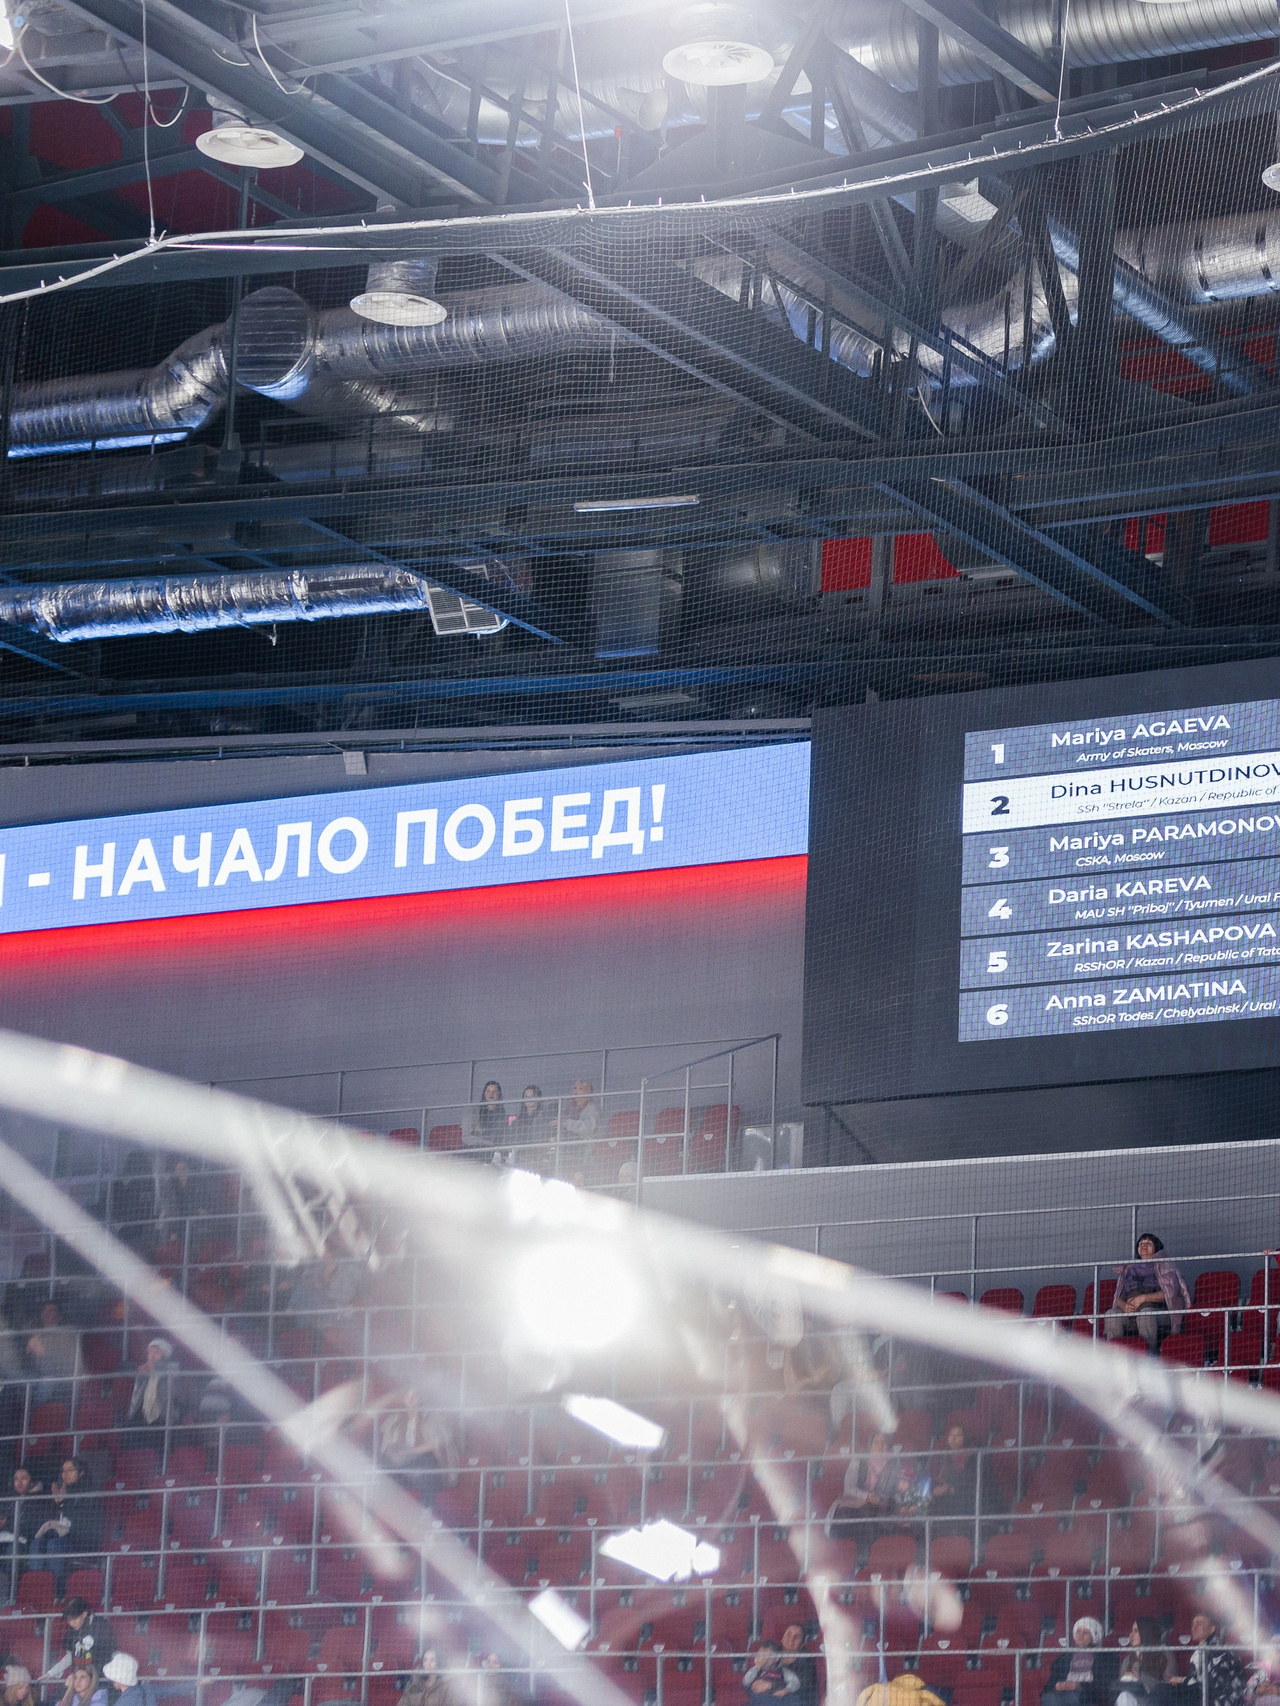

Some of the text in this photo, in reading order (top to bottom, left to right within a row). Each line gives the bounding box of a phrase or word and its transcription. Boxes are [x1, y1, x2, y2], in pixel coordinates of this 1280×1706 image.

[1051, 714, 1231, 748] Mariya AGAEVA
[991, 744, 1005, 764] 1
[1076, 739, 1229, 763] Army of Skaters, Moscow
[1051, 782, 1102, 799] Dina
[1077, 803, 1100, 814] SSh
[1150, 797, 1158, 807] /
[1158, 795, 1197, 806] Kazan
[1200, 791, 1207, 801] /
[1208, 787, 1262, 802] Republic
[1265, 784, 1279, 795] of
[990, 795, 1010, 816] 2
[72, 816, 369, 900] НАЧАЛО
[394, 783, 667, 870] ПОБЕД!
[1050, 832, 1125, 852] Mariya
[988, 846, 1010, 869] 3
[1075, 851, 1165, 867] CSKA, Moscow
[1049, 875, 1212, 904] Daria KAREVA
[988, 898, 1012, 920] 4
[1075, 909, 1104, 920] MAU
[1107, 907, 1125, 918] SH
[1175, 900, 1184, 911] /
[1184, 897, 1235, 911] Tyumen
[1235, 893, 1244, 906] /
[1245, 892, 1270, 904] Ural
[1047, 923, 1277, 957] Zarina KASHAPOVA
[987, 950, 1008, 973] 5
[1074, 959, 1125, 973] RSShOR
[1126, 957, 1135, 968] /
[1134, 955, 1174, 967] Kazan
[1175, 953, 1184, 965] /
[1184, 949, 1239, 964] Republic
[1241, 946, 1255, 958] of
[1045, 979, 1247, 1011] Anna ZAMIATINA
[986, 1004, 1009, 1025] 6
[1072, 1012, 1116, 1026] SShOR
[1118, 1010, 1154, 1022] Todes
[1154, 1008, 1164, 1020] /
[1163, 1003, 1240, 1019] Chelyabinsk
[1241, 1001, 1249, 1013] /
[1249, 999, 1276, 1012] Ural
